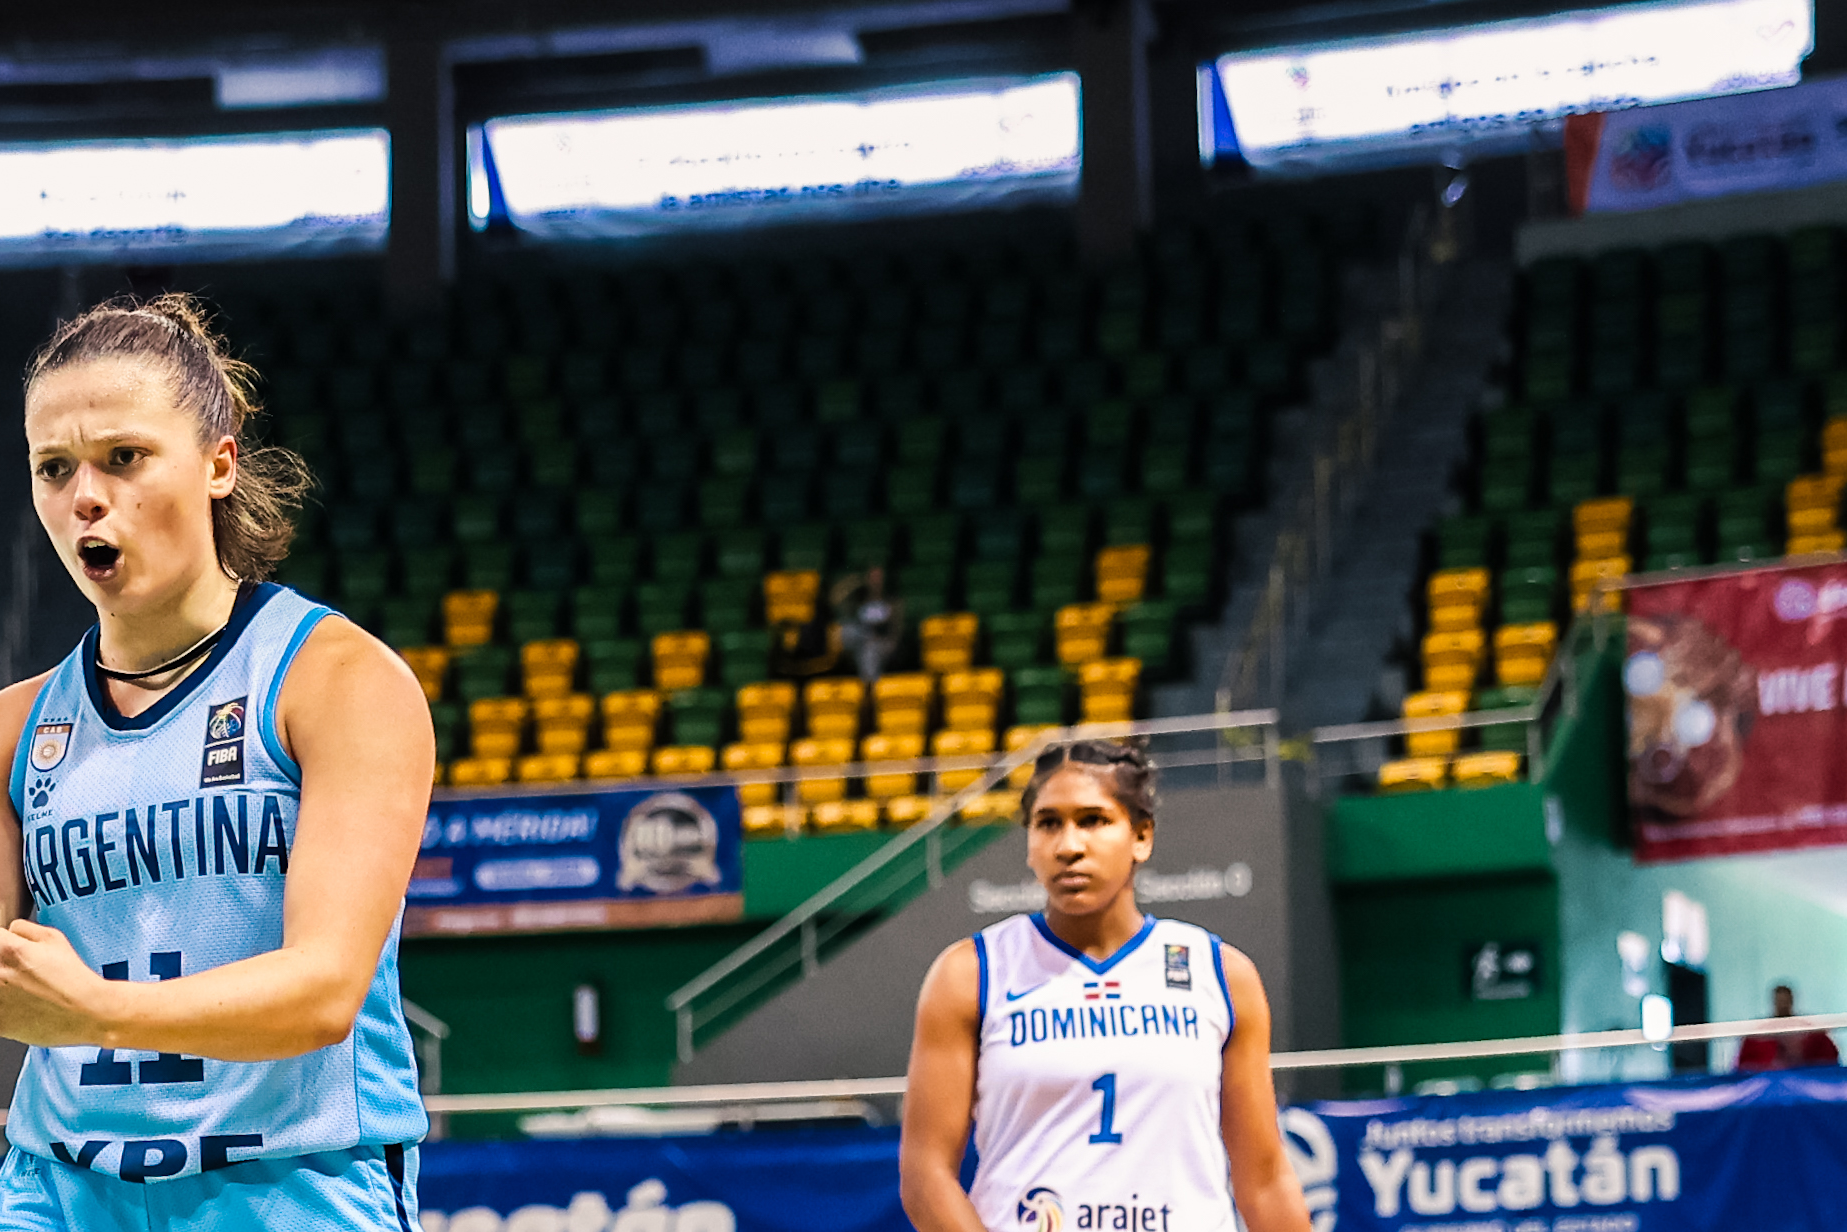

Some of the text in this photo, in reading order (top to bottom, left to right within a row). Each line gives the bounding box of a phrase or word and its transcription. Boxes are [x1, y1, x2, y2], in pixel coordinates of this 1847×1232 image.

[207, 746, 238, 766] FIBA
[25, 794, 289, 910] ARGENTINA
[1010, 1004, 1199, 1047] DOMINICANA
[1088, 1073, 1122, 1145] 1
[1358, 1133, 1681, 1218] Yucatán
